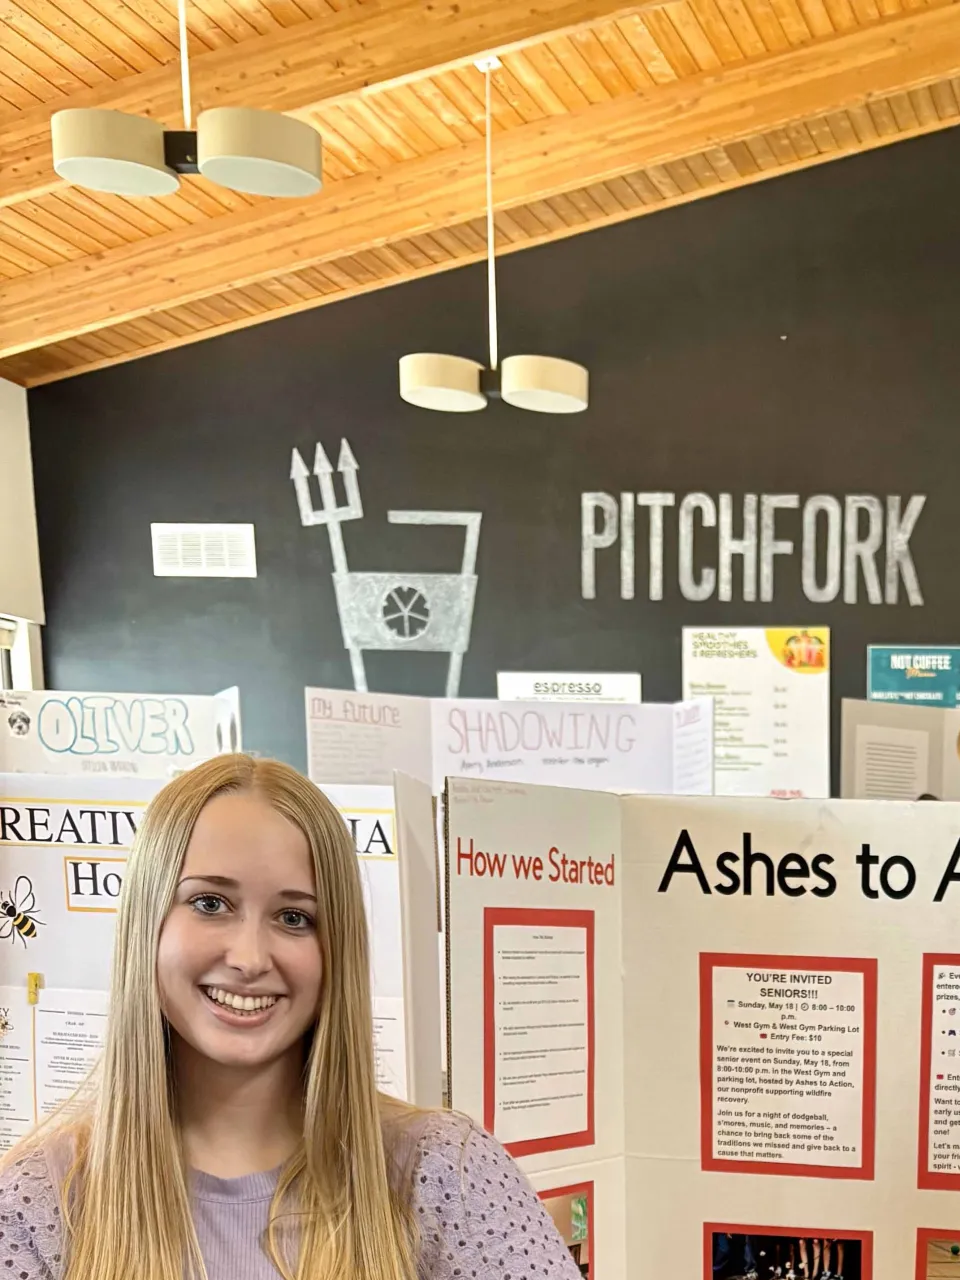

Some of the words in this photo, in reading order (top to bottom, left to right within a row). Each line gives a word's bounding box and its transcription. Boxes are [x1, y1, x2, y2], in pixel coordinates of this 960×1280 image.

[580, 491, 927, 607] PITCHFORK
[533, 681, 602, 694] espresso
[37, 696, 194, 755] OLIVER
[447, 707, 637, 754] SHADOWING
[457, 836, 507, 879] How
[512, 854, 544, 882] we
[548, 846, 615, 887] Started
[657, 828, 838, 898] Ashes
[855, 843, 917, 900] to
[746, 972, 787, 983] YOU'RE
[789, 974, 832, 985] INVITED
[759, 987, 818, 999] SENIORS!!!
[768, 1001, 783, 1010] May
[785, 1002, 794, 1010] 18
[811, 1003, 828, 1011] 8:00
[835, 1004, 855, 1012] 10:00
[733, 1020, 752, 1028] West
[752, 1021, 770, 1030] Gym
[778, 1022, 797, 1030] West
[798, 1023, 816, 1032] Gym
[817, 1024, 846, 1034] Parking
[847, 1025, 860, 1033] Lot
[770, 1032, 790, 1042] Entry
[808, 1034, 822, 1042] $10
[716, 1044, 737, 1052] We're
[738, 1046, 765, 1054] excited
[774, 1047, 795, 1055] invite
[811, 1048, 820, 1056] to
[826, 1050, 853, 1058] special
[716, 1055, 739, 1063] senior
[803, 1058, 818, 1068] May
[832, 1059, 850, 1067] from
[716, 1075, 744, 1084] parking
[758, 1076, 783, 1085] hosted
[784, 1078, 794, 1087] by
[795, 1078, 818, 1086] Ashes
[730, 1086, 764, 1094] nonprofit
[765, 1088, 804, 1097] supporting
[805, 1089, 832, 1097] wildfire
